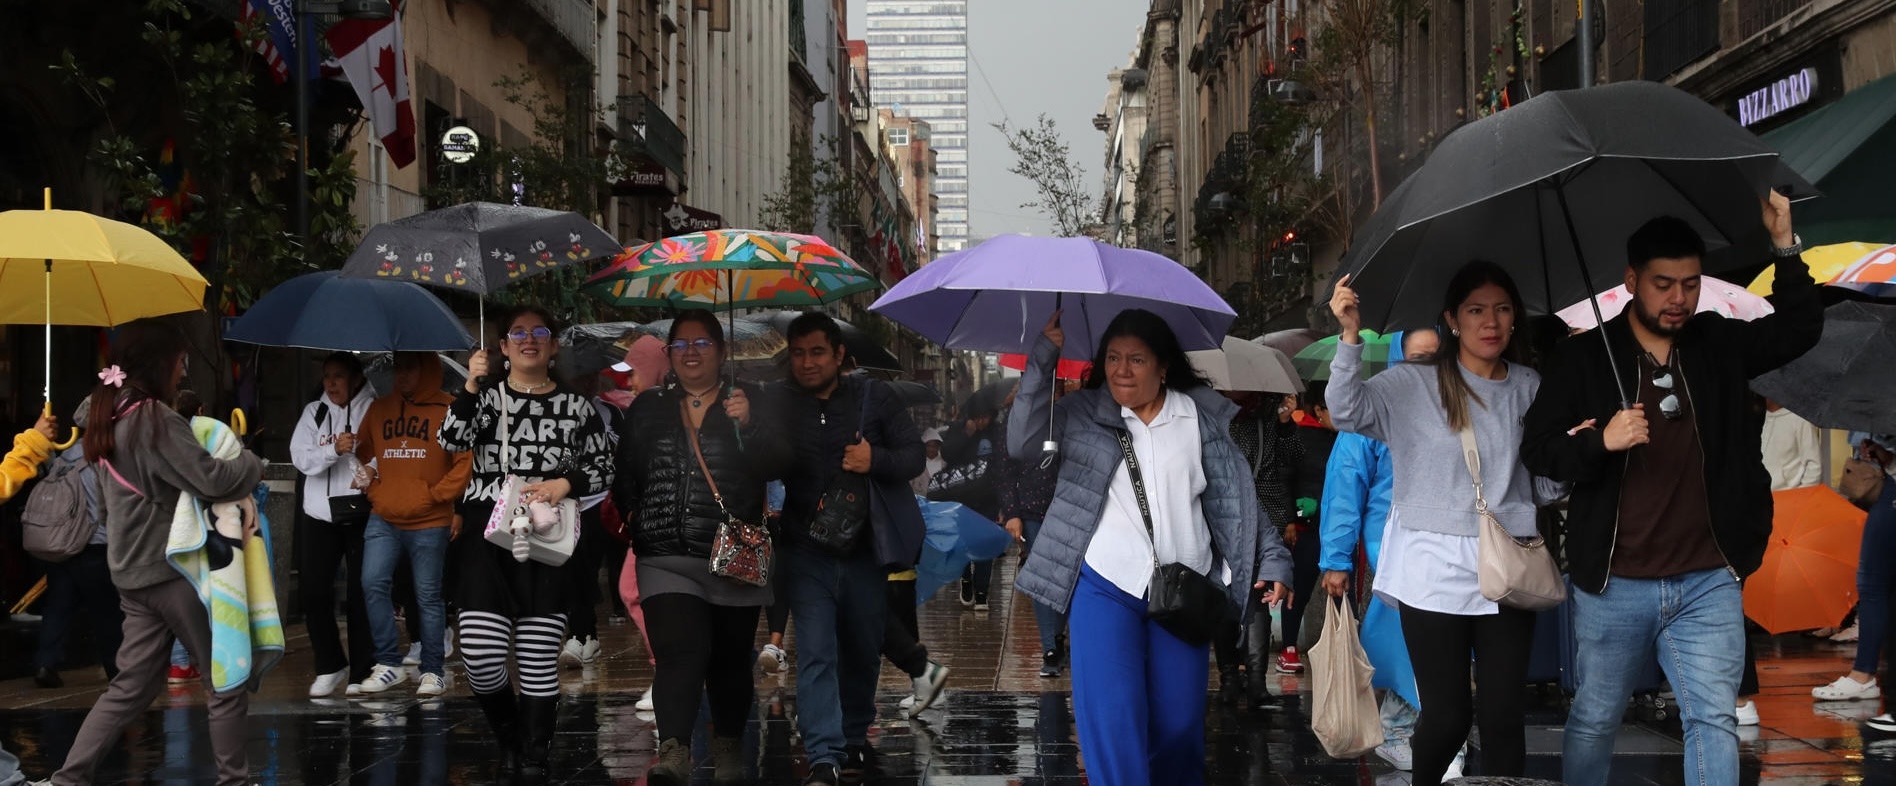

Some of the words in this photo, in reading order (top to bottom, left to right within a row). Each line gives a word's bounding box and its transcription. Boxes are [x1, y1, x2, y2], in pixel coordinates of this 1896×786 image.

[1738, 68, 1812, 127] BIZZARRO
[383, 416, 430, 441] GOGA
[495, 415, 578, 443] EART
[383, 448, 427, 459] ATHLETIC
[1121, 436, 1137, 468] NAUTICA
[1136, 480, 1149, 516] NAUTICA
